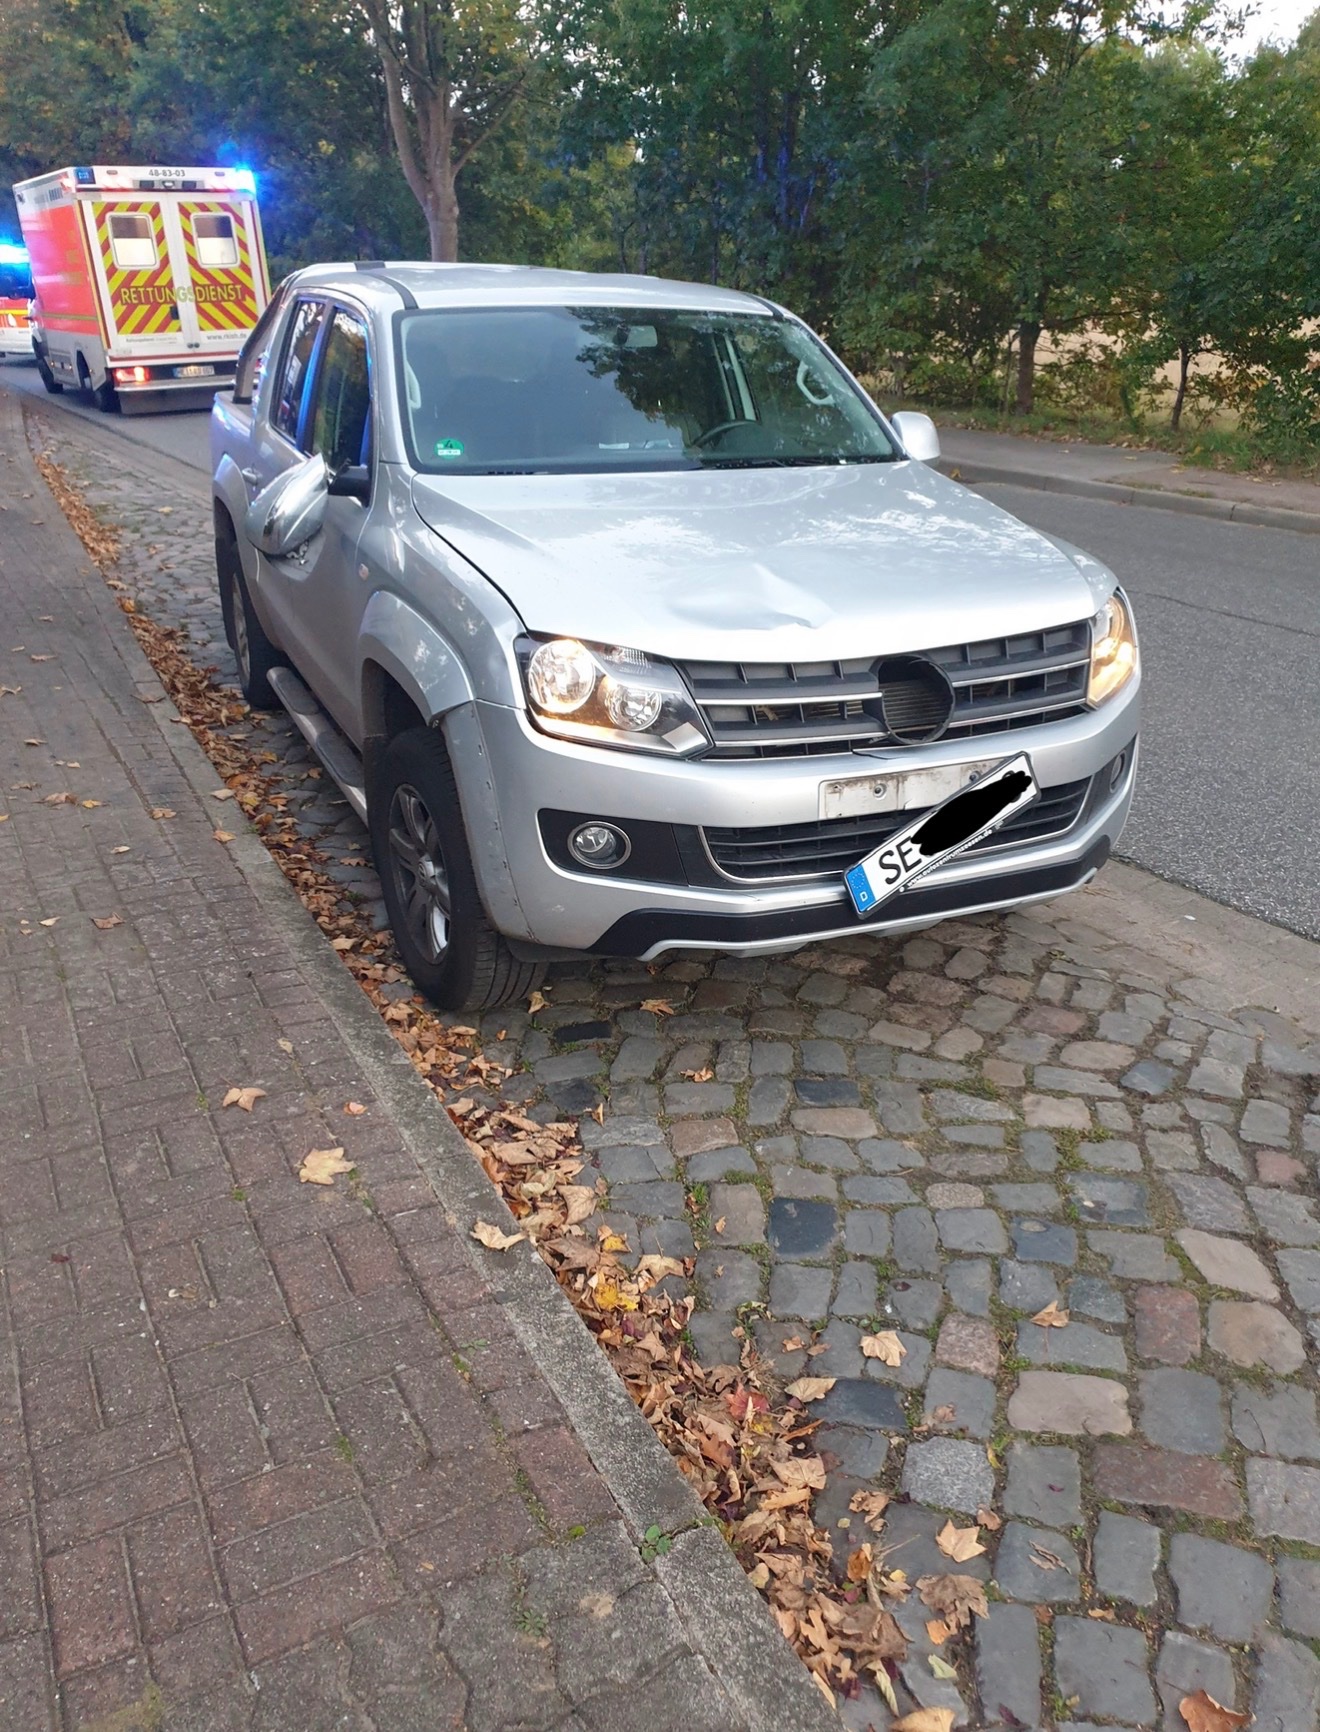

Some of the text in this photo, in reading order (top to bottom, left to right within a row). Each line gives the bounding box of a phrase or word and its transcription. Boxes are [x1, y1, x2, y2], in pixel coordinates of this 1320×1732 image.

[148, 169, 186, 177] 48-83-03
[120, 284, 243, 304] RETTUNGSDIENST
[878, 836, 923, 885] SE
[859, 891, 869, 902] D
